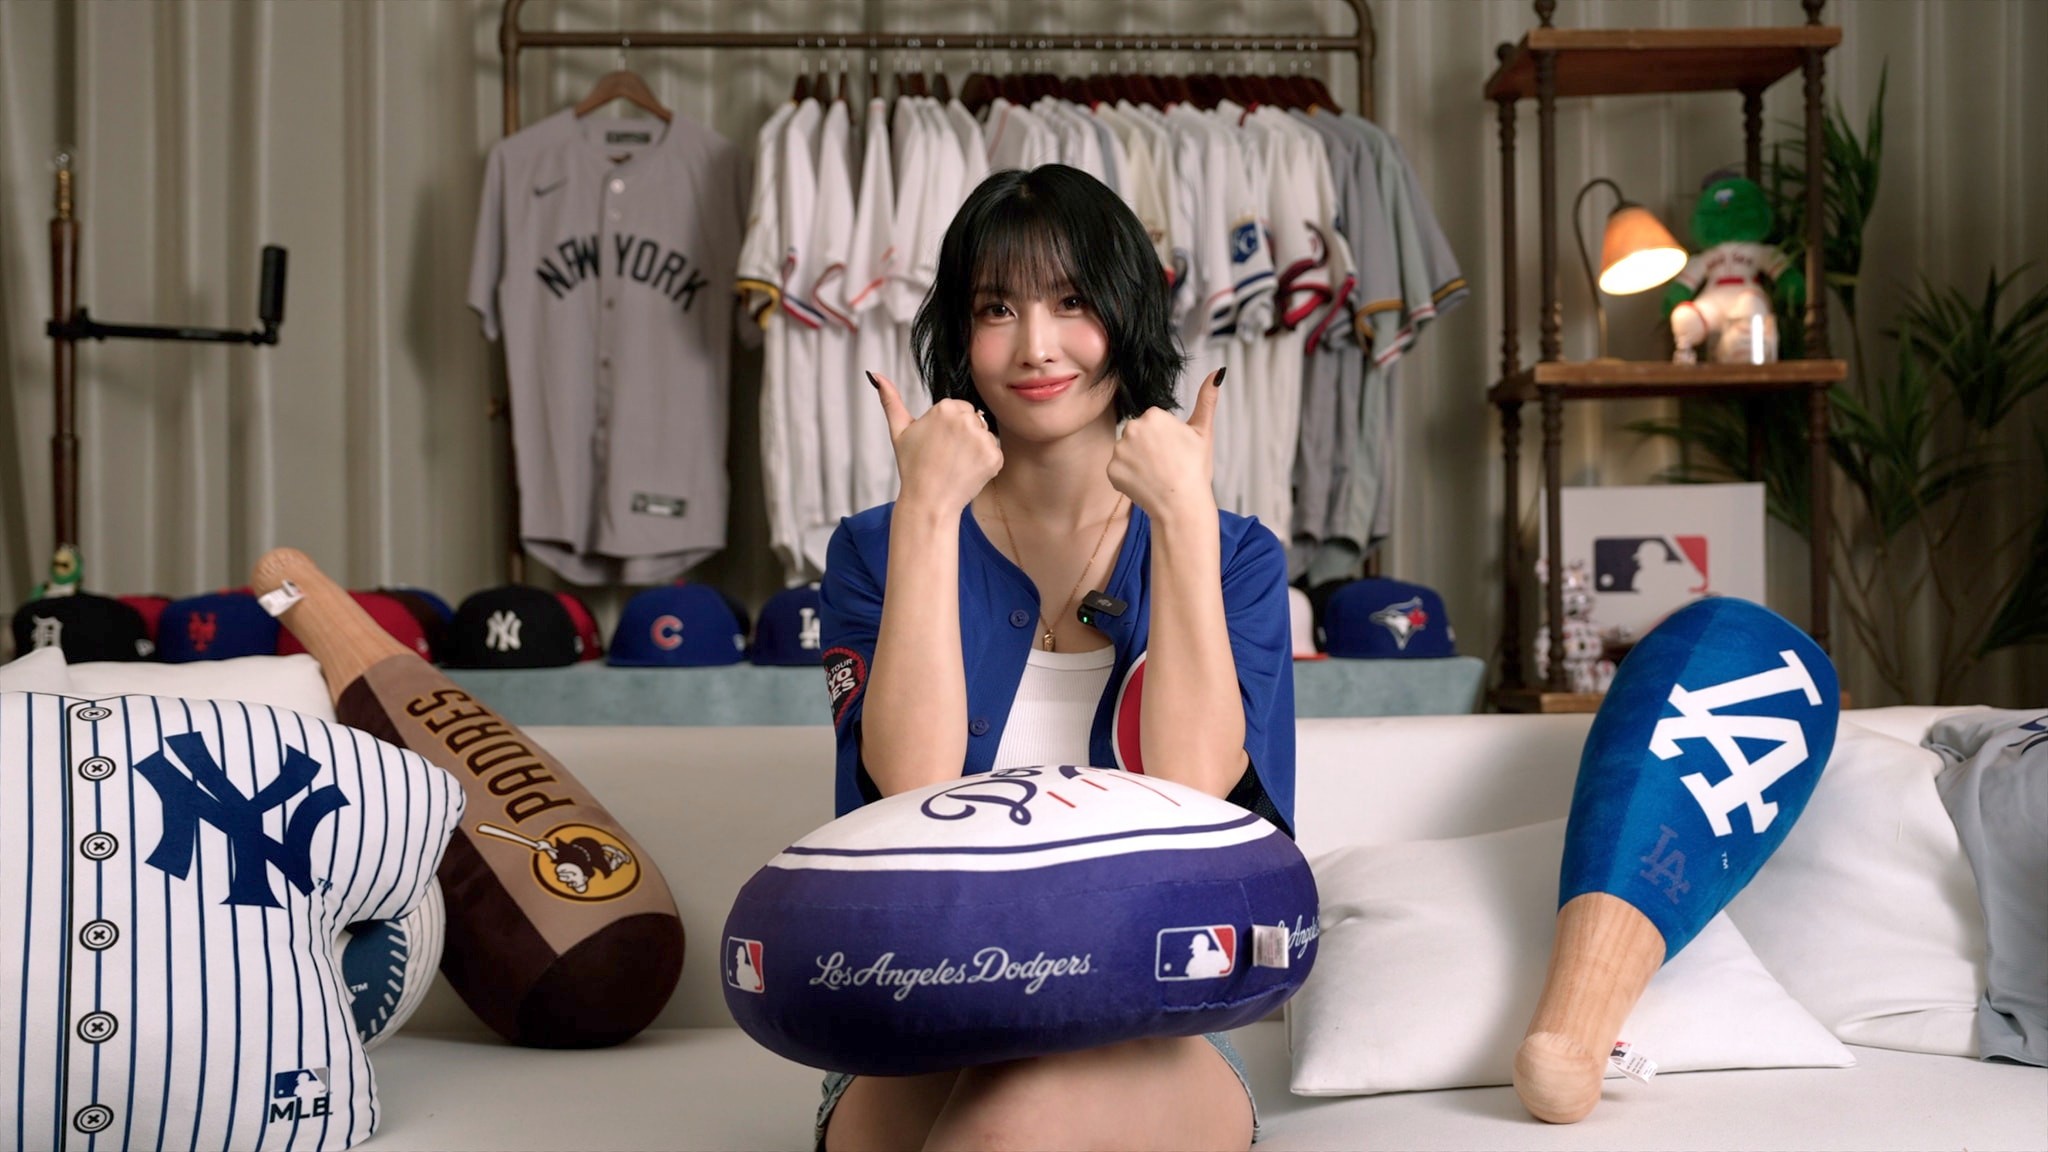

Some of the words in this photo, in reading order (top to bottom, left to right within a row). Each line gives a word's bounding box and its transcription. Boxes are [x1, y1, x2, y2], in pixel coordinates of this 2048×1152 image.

[614, 232, 709, 312] YORK
[485, 609, 523, 651] NY
[651, 614, 684, 650] C
[831, 658, 853, 675] TOUR
[406, 688, 576, 825] PADRES
[1649, 649, 1822, 838] LA
[132, 731, 351, 910] NY
[1638, 824, 1690, 905] LA
[350, 982, 368, 993] TM
[809, 951, 852, 990] Los
[853, 953, 967, 1001] Angeles
[967, 946, 1091, 994] Dodgers
[269, 1095, 331, 1123] MLB
